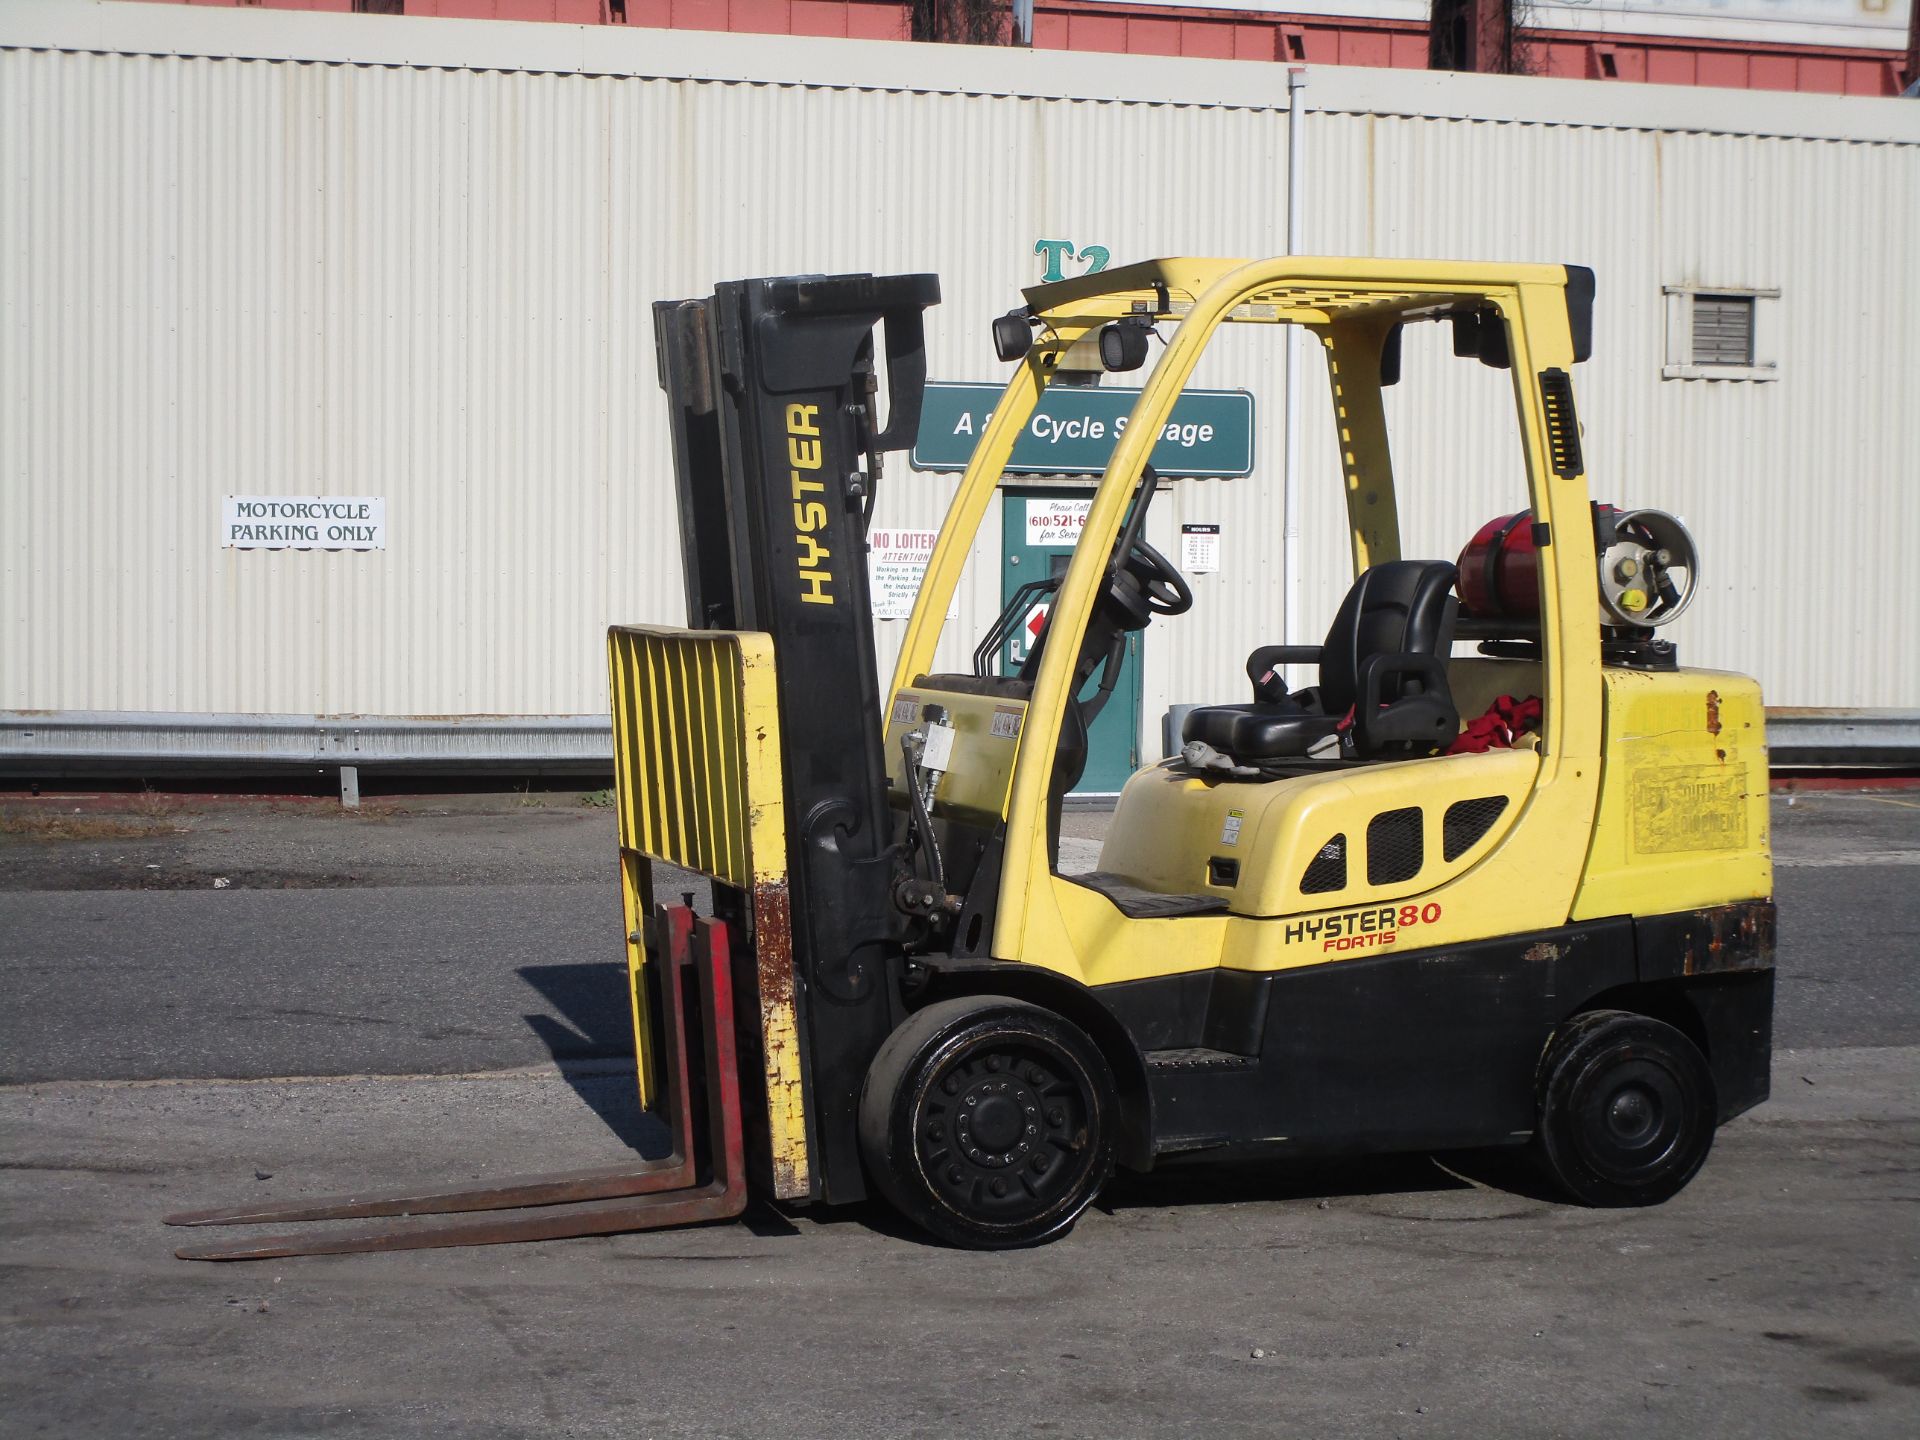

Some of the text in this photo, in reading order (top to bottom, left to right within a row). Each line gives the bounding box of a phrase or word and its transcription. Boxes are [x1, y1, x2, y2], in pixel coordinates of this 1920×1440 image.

[1034, 239, 1111, 283] T2
[953, 412, 973, 435] A
[1031, 414, 1105, 443] Cycle
[1113, 416, 1214, 447] Svage
[237, 503, 370, 519] MOTORCYCLE
[785, 403, 834, 605] HYSTER
[1049, 503, 1090, 511] Please Call
[231, 525, 377, 541] PARKING ONLY
[873, 533, 939, 549] NO LOITER
[1039, 529, 1080, 542] for Serv
[1285, 902, 1442, 945] HYSTER 80
[1323, 931, 1396, 953] FORTIS
